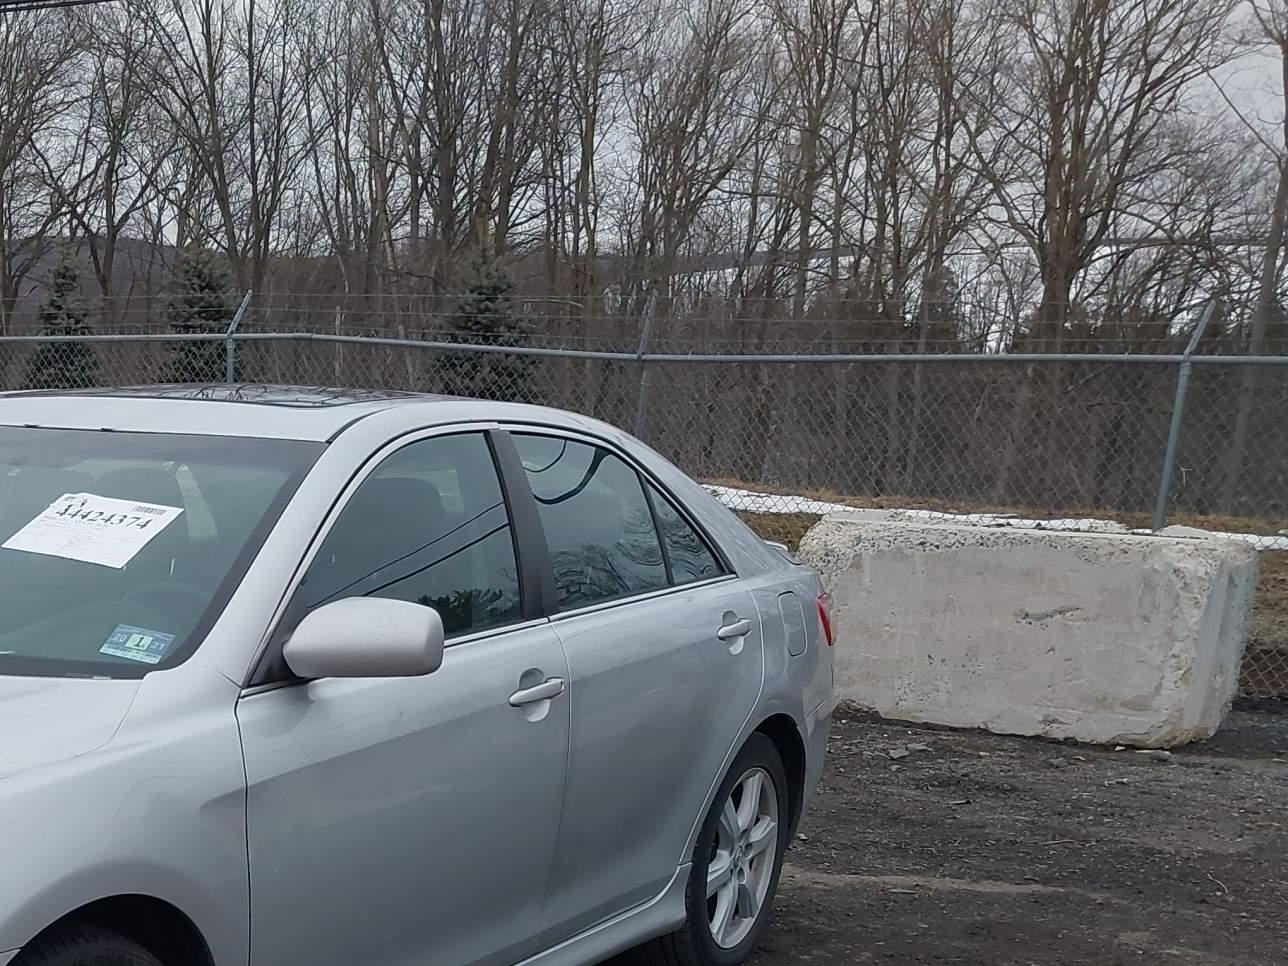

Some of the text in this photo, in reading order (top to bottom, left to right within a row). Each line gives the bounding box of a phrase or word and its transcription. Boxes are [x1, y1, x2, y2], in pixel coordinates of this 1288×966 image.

[55, 503, 154, 530] 44424374
[111, 632, 128, 643] 20
[133, 636, 146, 648] 1
